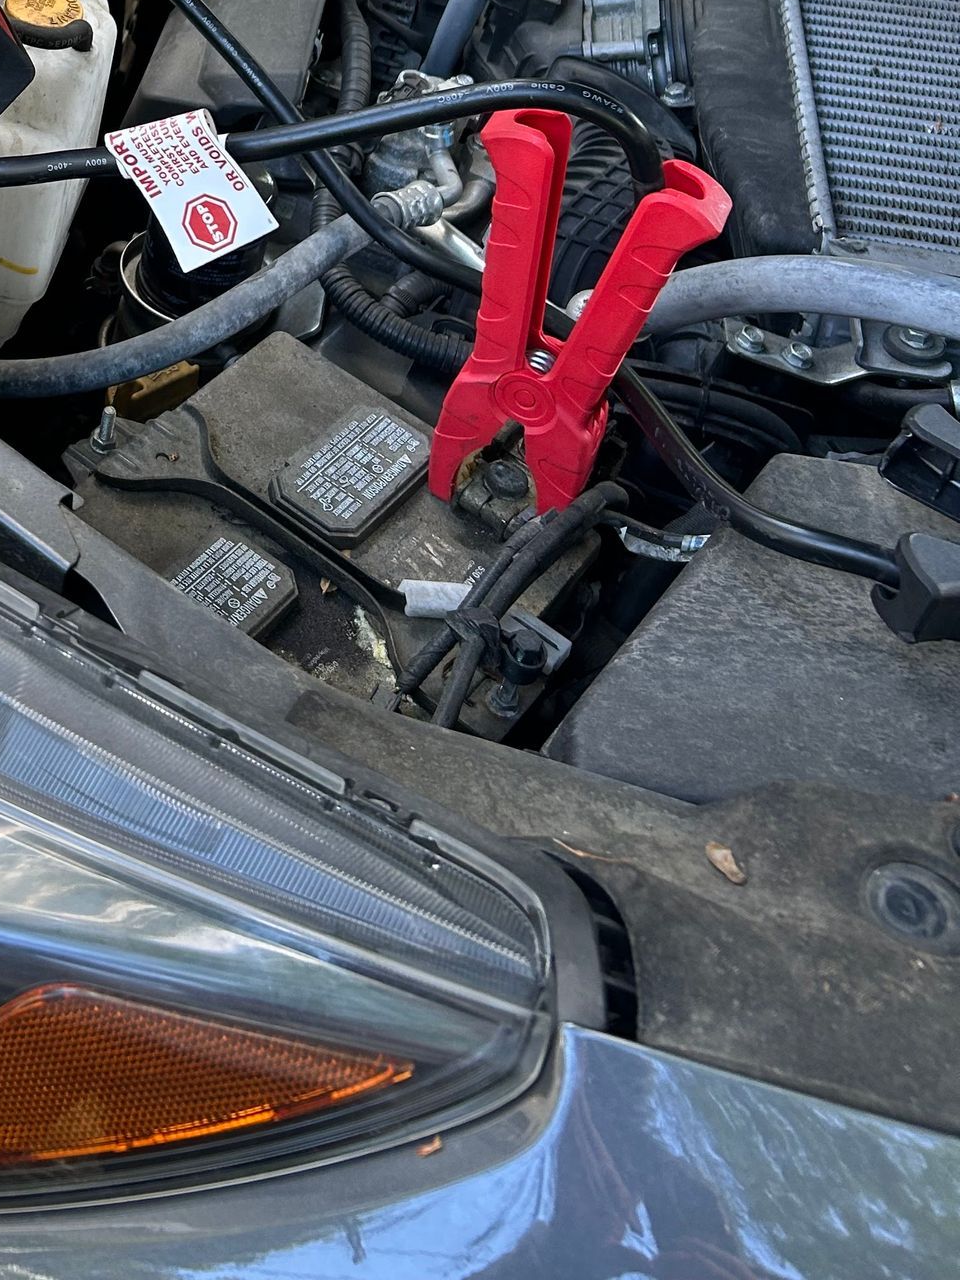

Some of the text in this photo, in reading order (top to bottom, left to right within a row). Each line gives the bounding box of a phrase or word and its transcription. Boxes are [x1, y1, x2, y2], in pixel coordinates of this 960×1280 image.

[486, 83, 514, 93] 600V
[531, 82, 566, 92] Cable
[582, 90, 624, 114] #2AWG
[129, 134, 171, 185] YOU MUST
[147, 122, 187, 174] FIRST USE
[172, 144, 199, 174] EVERY
[188, 149, 208, 170] AND
[190, 125, 227, 169] VOIDS
[85, 157, 107, 168] 600V
[224, 169, 245, 192] OR
[196, 204, 225, 243] STOP
[361, 458, 406, 501] DANGER/POISON
